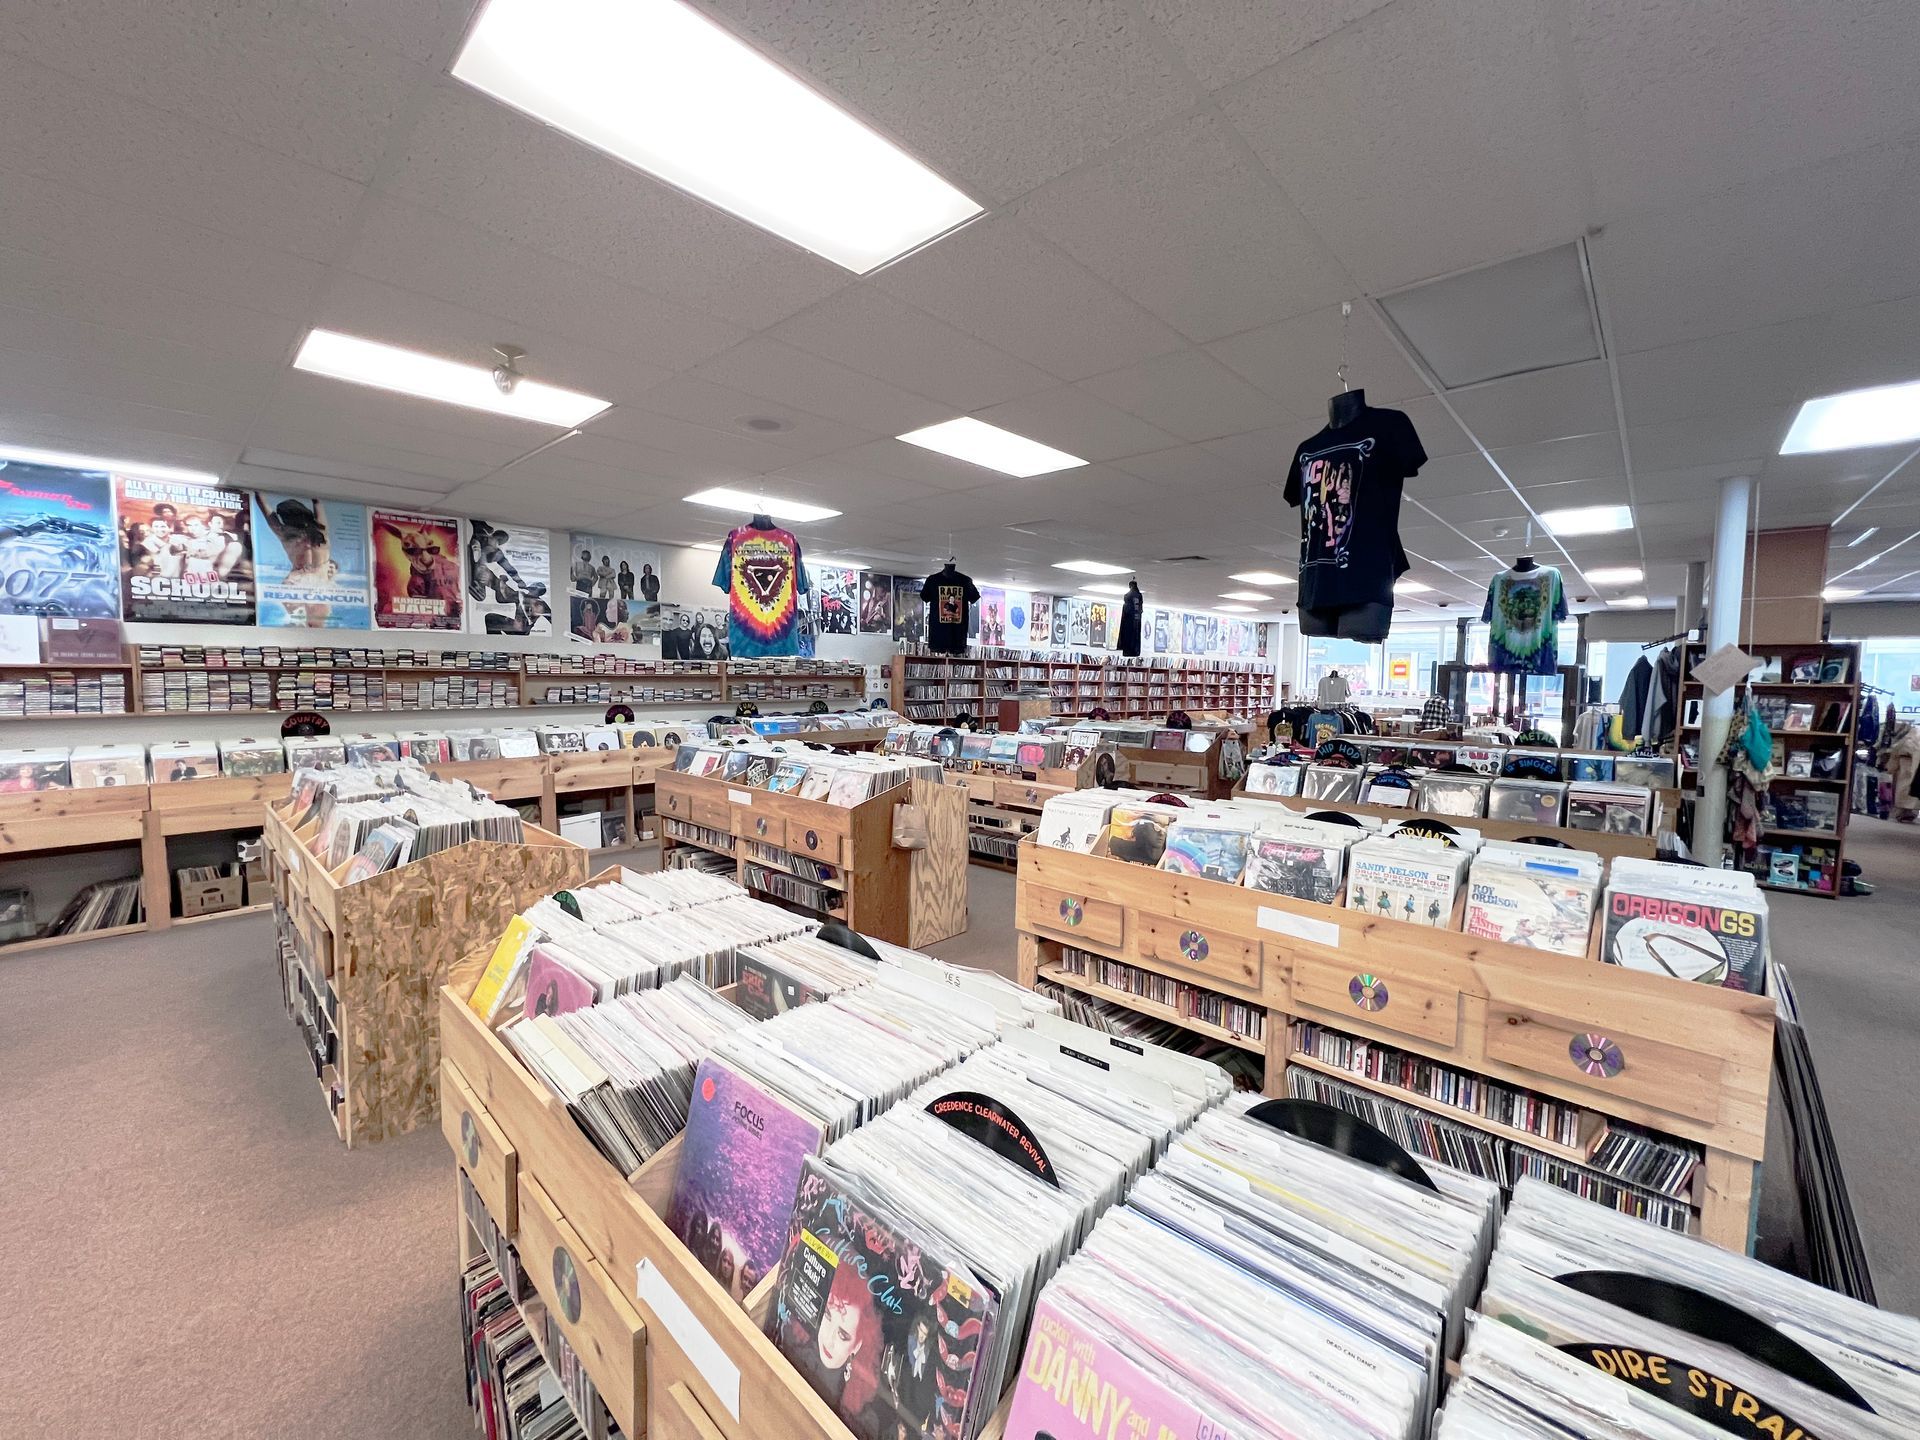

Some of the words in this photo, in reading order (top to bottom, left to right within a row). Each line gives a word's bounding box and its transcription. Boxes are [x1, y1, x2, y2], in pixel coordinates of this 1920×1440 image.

[184, 571, 218, 584] OLD
[131, 576, 247, 600] SCHOOL
[264, 592, 299, 600] REAL
[303, 593, 364, 603] CANCUN
[940, 587, 963, 596] RAGE
[393, 603, 445, 615] JACK
[283, 716, 329, 728] COUNTRY
[1319, 744, 1334, 755] HIP
[1339, 744, 1360, 759] HOP
[1519, 759, 1556, 775] SINGLES
[1396, 827, 1451, 848] IRVANA
[1355, 869, 1380, 877] DRUM
[1383, 873, 1450, 888] DISCOTHEQUE
[1356, 861, 1387, 873] SANDY
[1389, 866, 1430, 880] NELSON
[1472, 884, 1496, 896] ROY
[1471, 893, 1519, 909] ORBISON
[1469, 906, 1489, 919] The
[1612, 893, 1756, 937] ORBISONGS
[943, 971, 961, 987] YES
[734, 1101, 765, 1131] FOCUS
[934, 1101, 974, 1114] CREEDENCE
[975, 1105, 1019, 1139] CLEARWATER
[1019, 1136, 1047, 1173] REVIVAL
[803, 1246, 827, 1278] Culture
[803, 1261, 821, 1287] Club!
[867, 1274, 902, 1314] Club
[1072, 1336, 1096, 1366] with
[1326, 1338, 1342, 1352] DEAD
[1343, 1348, 1356, 1360] CAN
[1356, 1355, 1377, 1371] DANCE
[1026, 1331, 1131, 1440] DANNY
[1126, 1409, 1150, 1438] and
[1308, 1370, 1326, 1386] CHRIS
[1326, 1380, 1360, 1405] DAUGHTRY
[1591, 1348, 1671, 1385] DIRE
[1687, 1369, 1818, 1440] STRA
